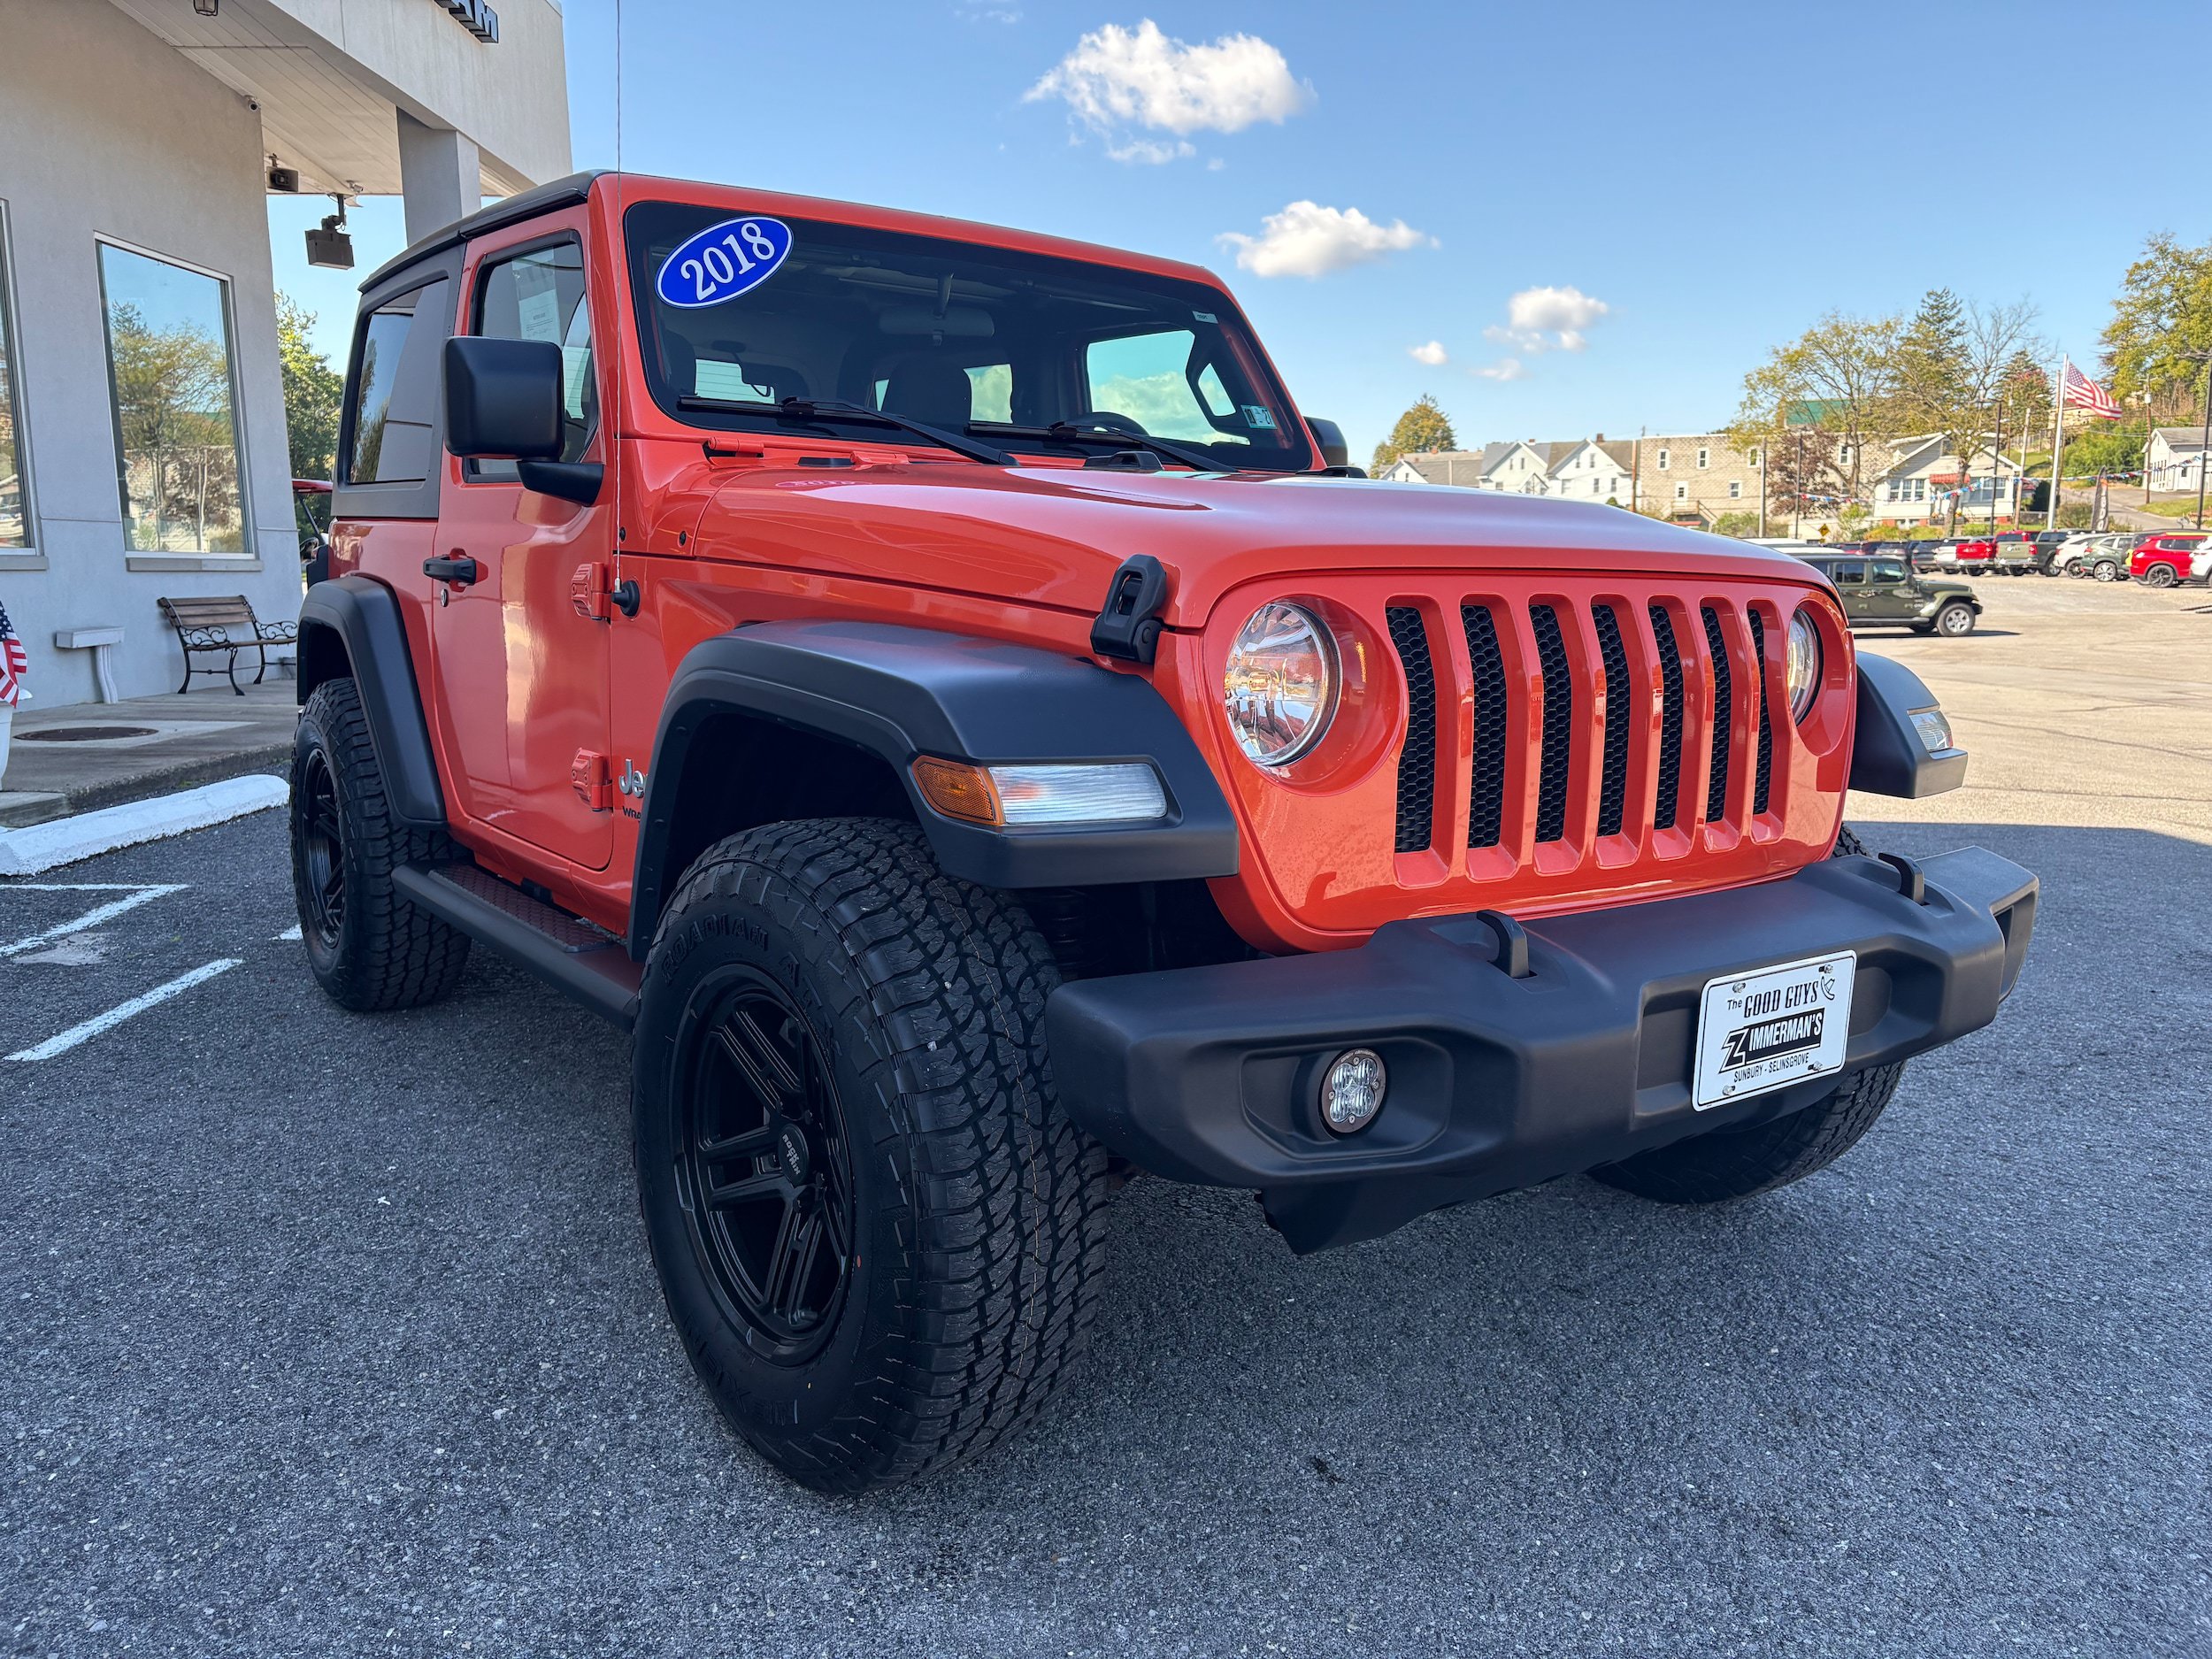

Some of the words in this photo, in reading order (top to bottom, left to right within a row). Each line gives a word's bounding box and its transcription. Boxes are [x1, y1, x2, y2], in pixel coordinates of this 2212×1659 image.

[680, 222, 775, 302] 2018
[618, 758, 647, 798] Je
[1727, 998, 1743, 1011] The
[1744, 988, 1781, 1018] GOOD
[1785, 980, 1819, 1009] GUYS
[1718, 1011, 1824, 1074] ZIMMERMAN'S
[1733, 1064, 1764, 1083] SUNBURY
[1770, 1052, 1810, 1073] SELINSGROVE
